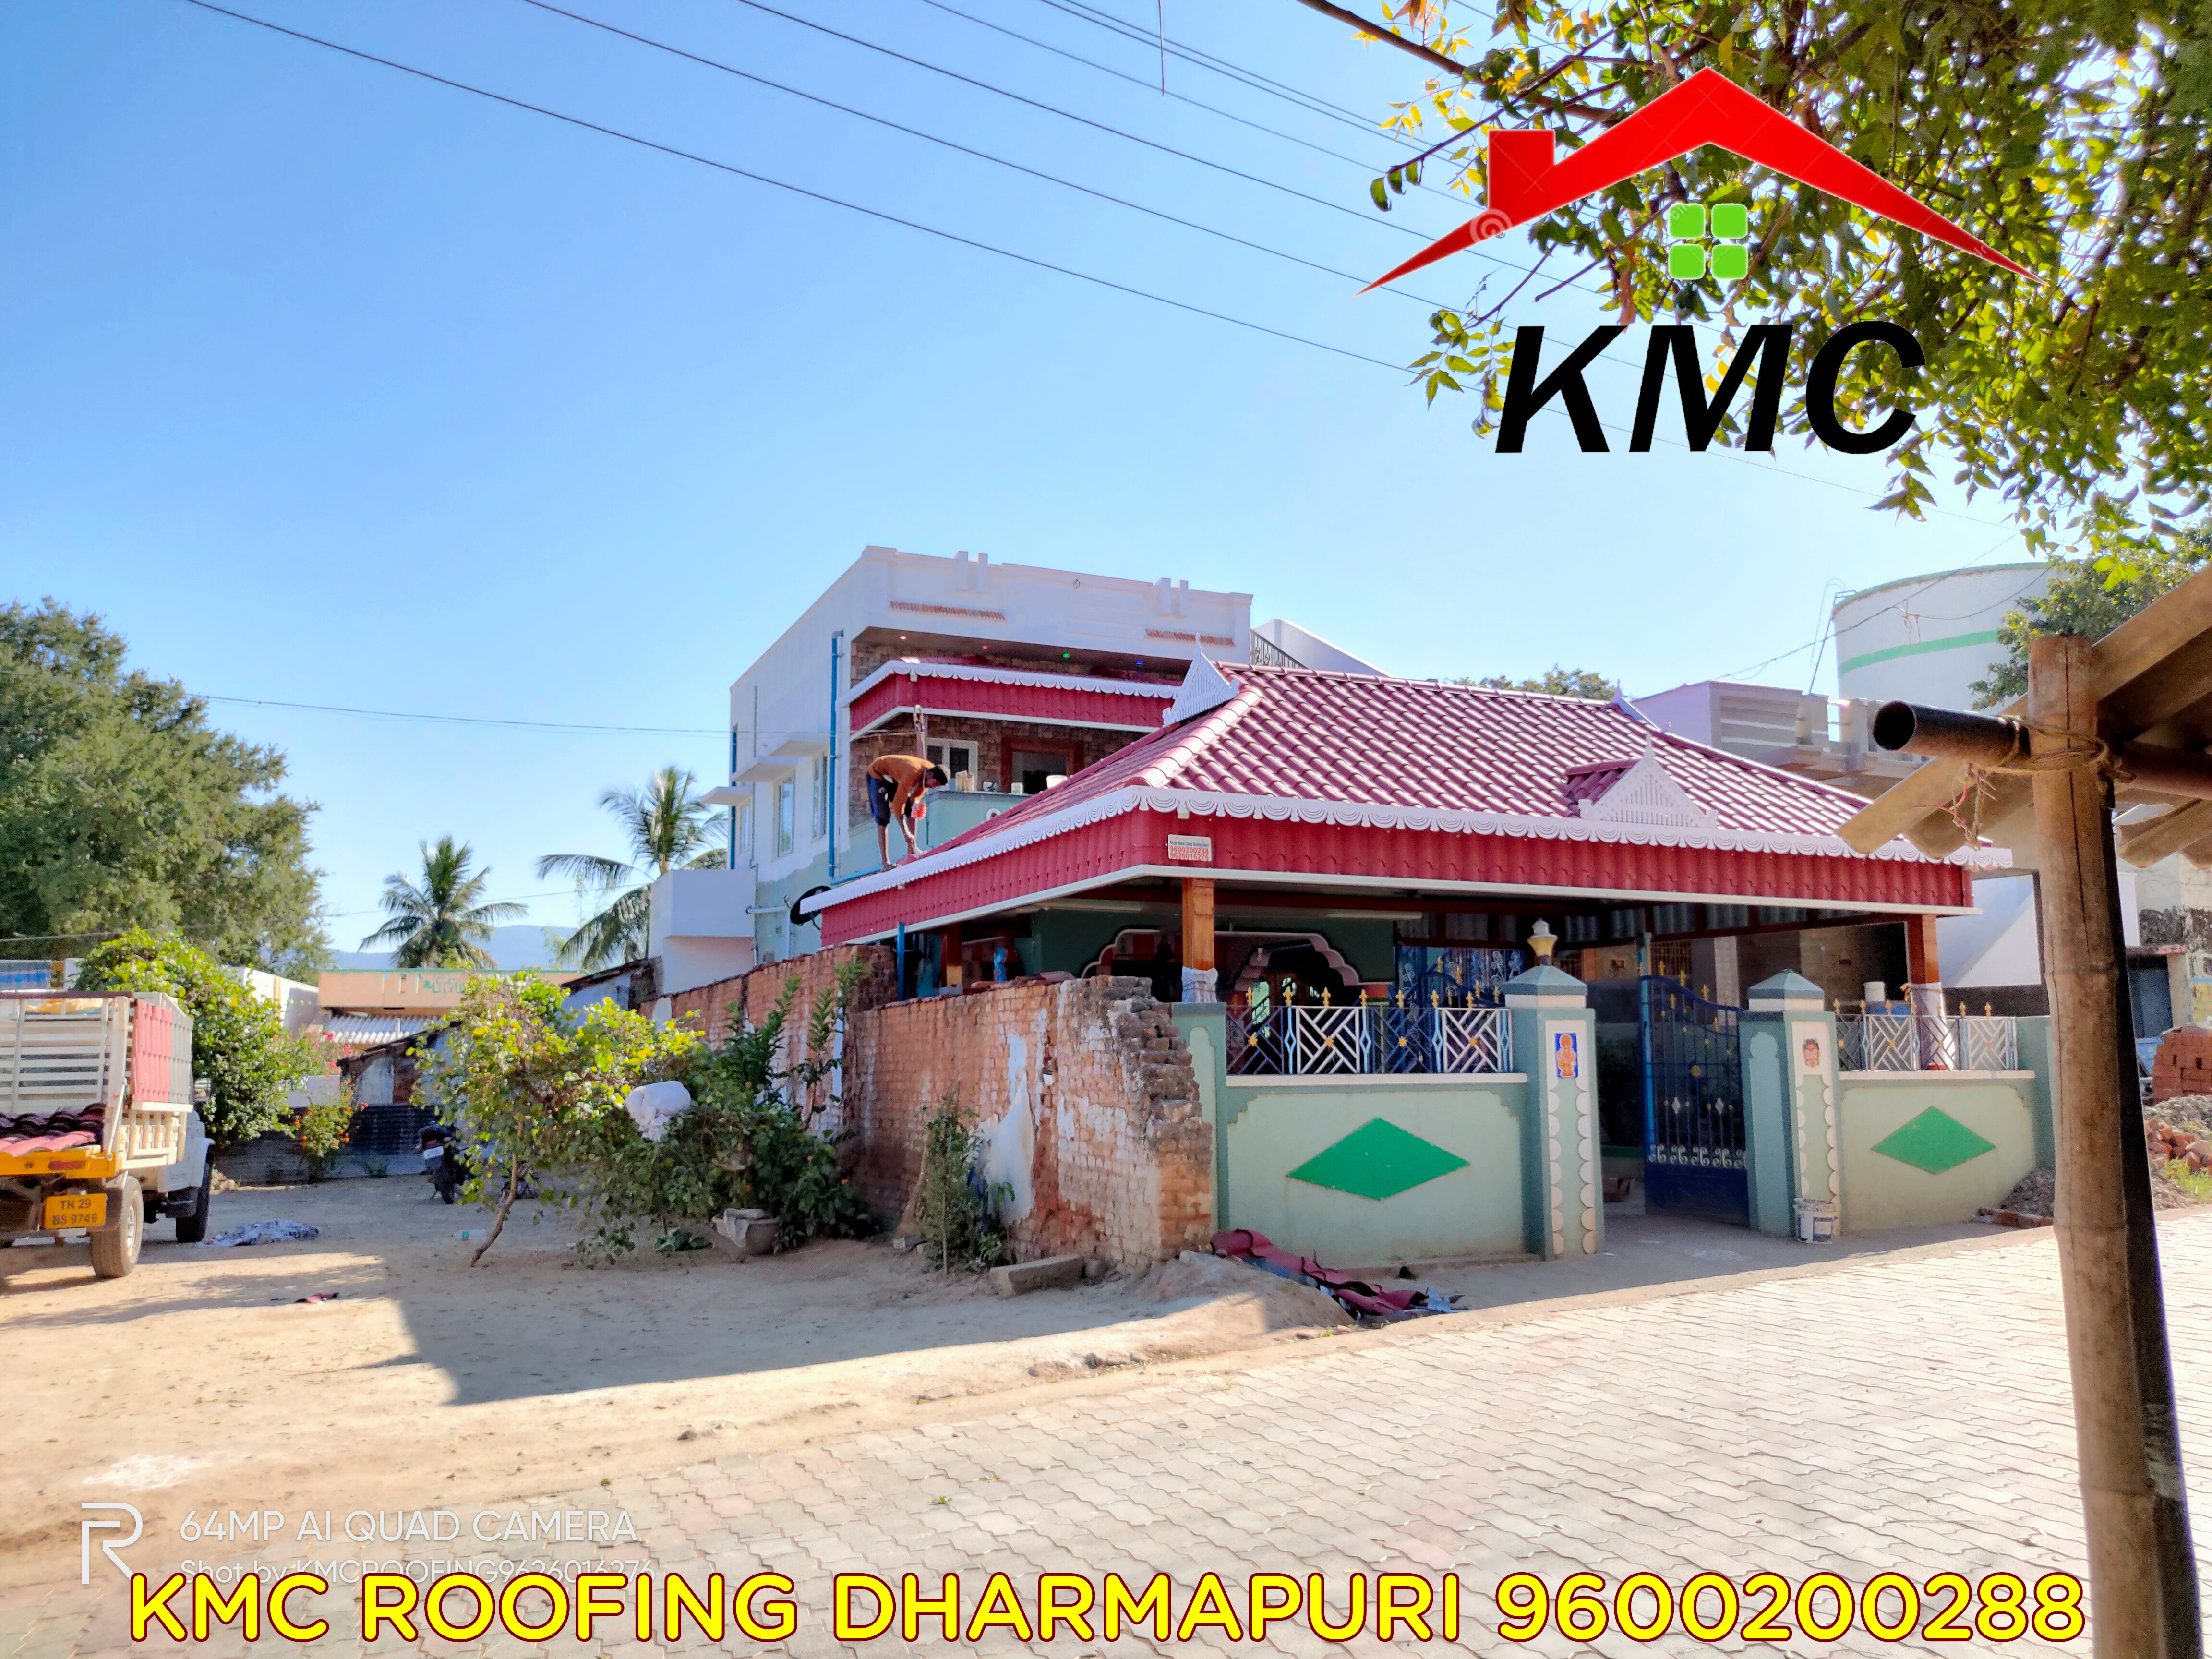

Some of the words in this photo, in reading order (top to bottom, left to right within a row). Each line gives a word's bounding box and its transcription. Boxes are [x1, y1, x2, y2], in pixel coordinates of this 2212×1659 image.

[1170, 846, 1209, 854] 9600200288
[1170, 852, 1209, 861] 9626016276
[60, 1200, 75, 1210] TN
[78, 1199, 91, 1209] 29
